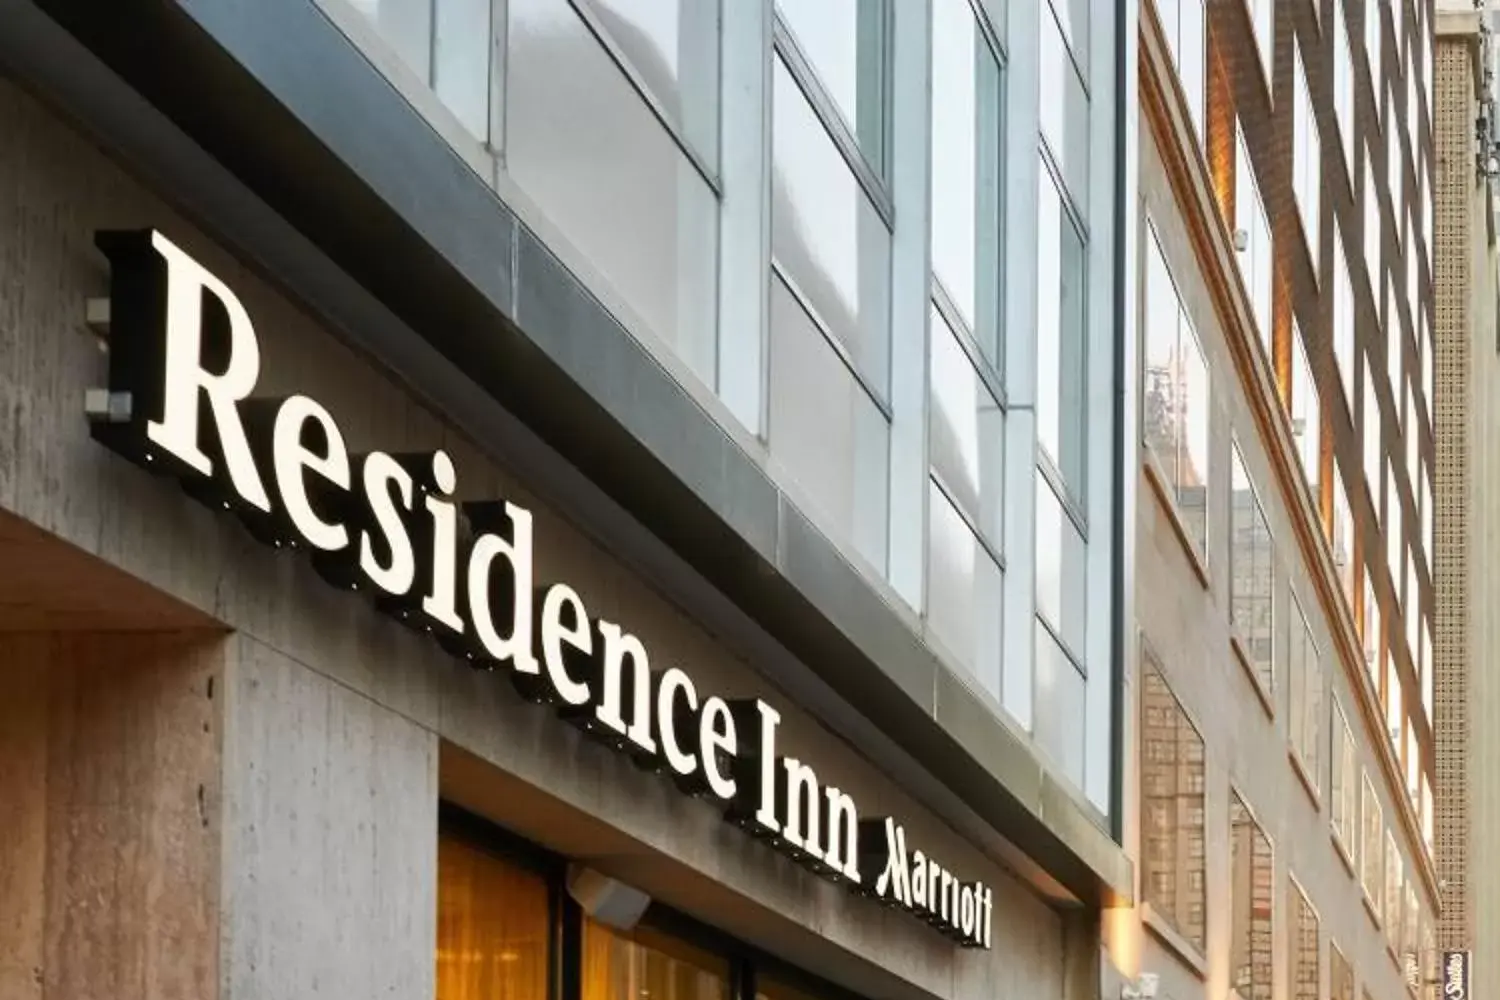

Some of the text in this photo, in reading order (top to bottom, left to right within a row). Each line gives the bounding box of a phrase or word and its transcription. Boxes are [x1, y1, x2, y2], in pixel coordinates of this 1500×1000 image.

[147, 229, 993, 949] Residence Inn Marriott
[1445, 953, 1464, 1000] Suites
